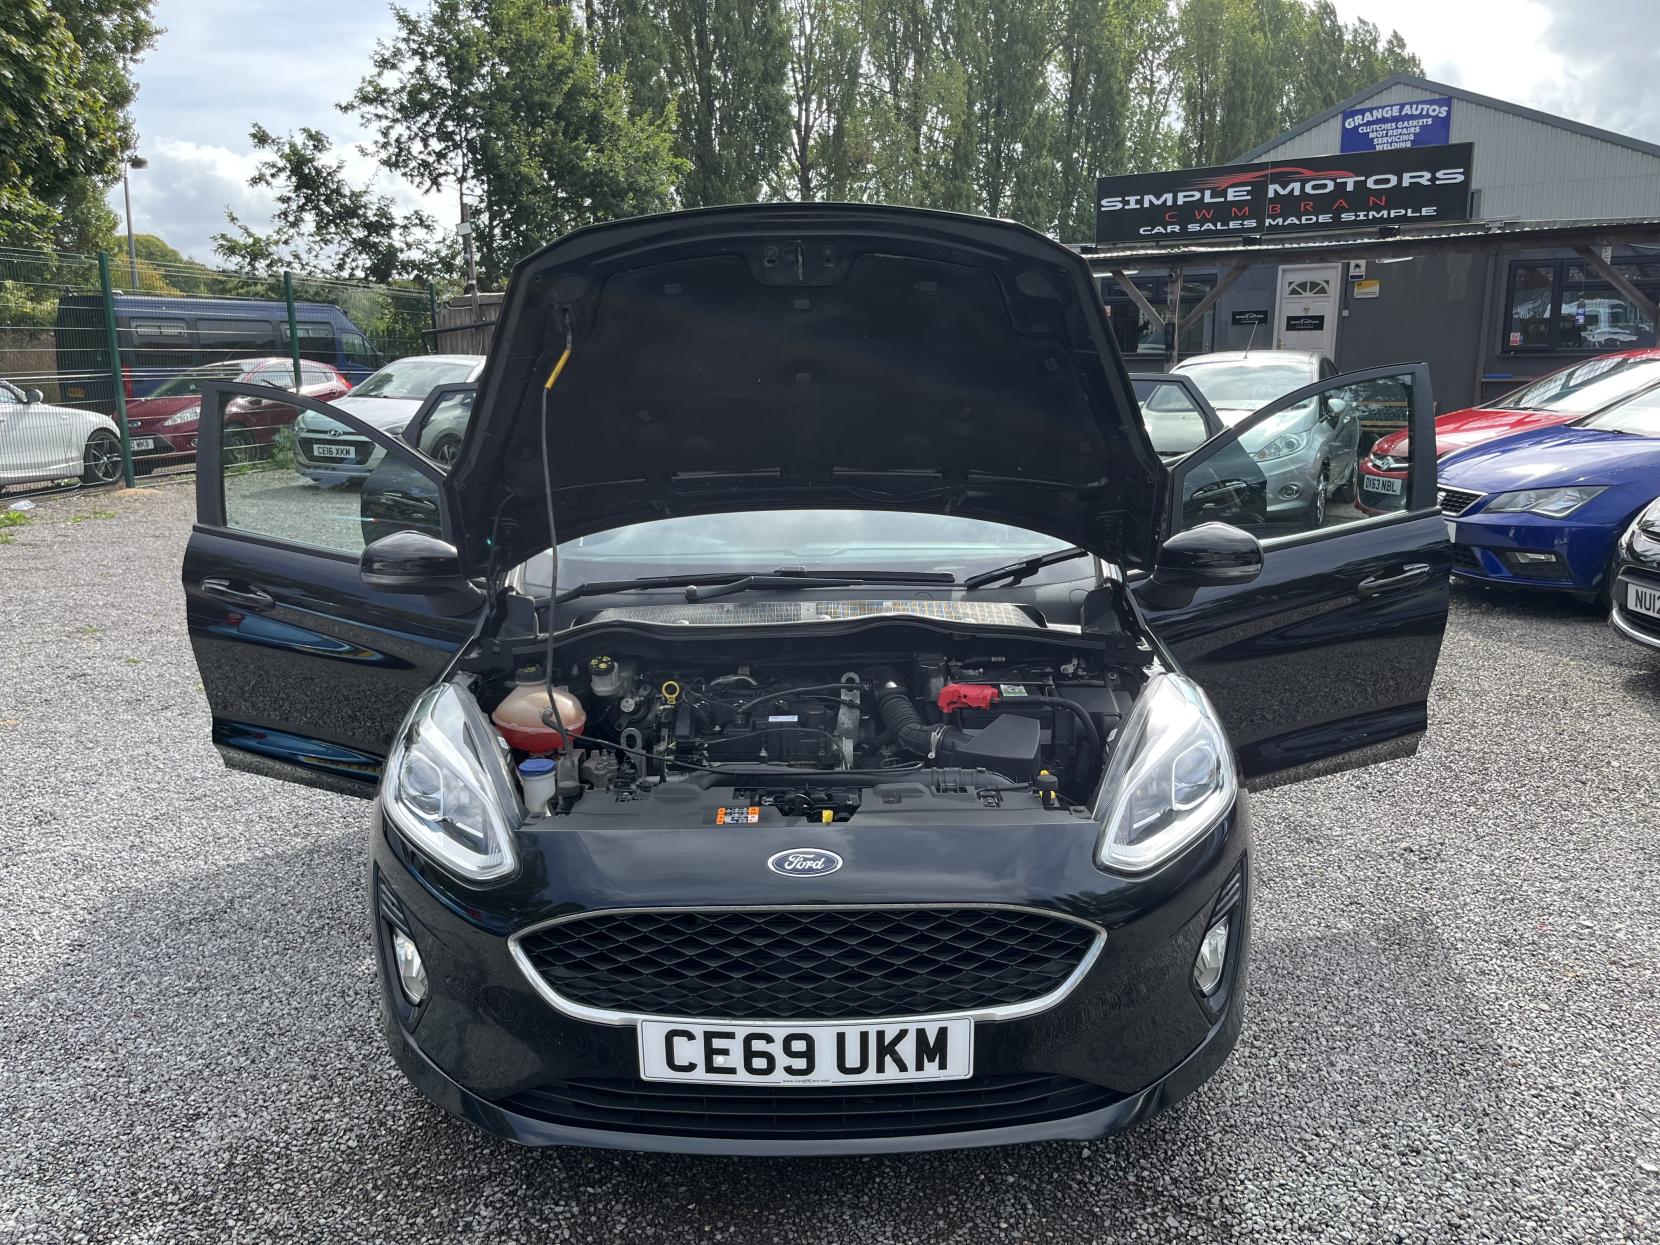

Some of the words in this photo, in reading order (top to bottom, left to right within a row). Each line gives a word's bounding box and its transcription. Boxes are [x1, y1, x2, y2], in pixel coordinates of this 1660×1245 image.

[1345, 105, 1400, 129] GRANGE
[1401, 104, 1448, 118] AUTOS
[1358, 122, 1396, 133] CLUTCHES
[1397, 118, 1432, 128] GASKETS
[1369, 130, 1387, 139] MOT
[1387, 126, 1420, 137] REPAIRS
[1373, 133, 1414, 145] SERVICING
[1375, 140, 1411, 151] WELDING
[1100, 186, 1252, 212] SIMPLE
[1267, 168, 1465, 198] MOTORS
[1139, 225, 1181, 235] CAR
[1187, 219, 1257, 232] SALES
[1265, 214, 1333, 227] MADE
[1340, 206, 1437, 222] SIMPLE
[317, 446, 333, 456] CE16
[334, 447, 350, 457] XKM
[1381, 479, 1397, 493] NBL
[784, 854, 825, 870] Ford
[664, 1029, 816, 1076] CE69
[836, 1026, 949, 1075] UKM
